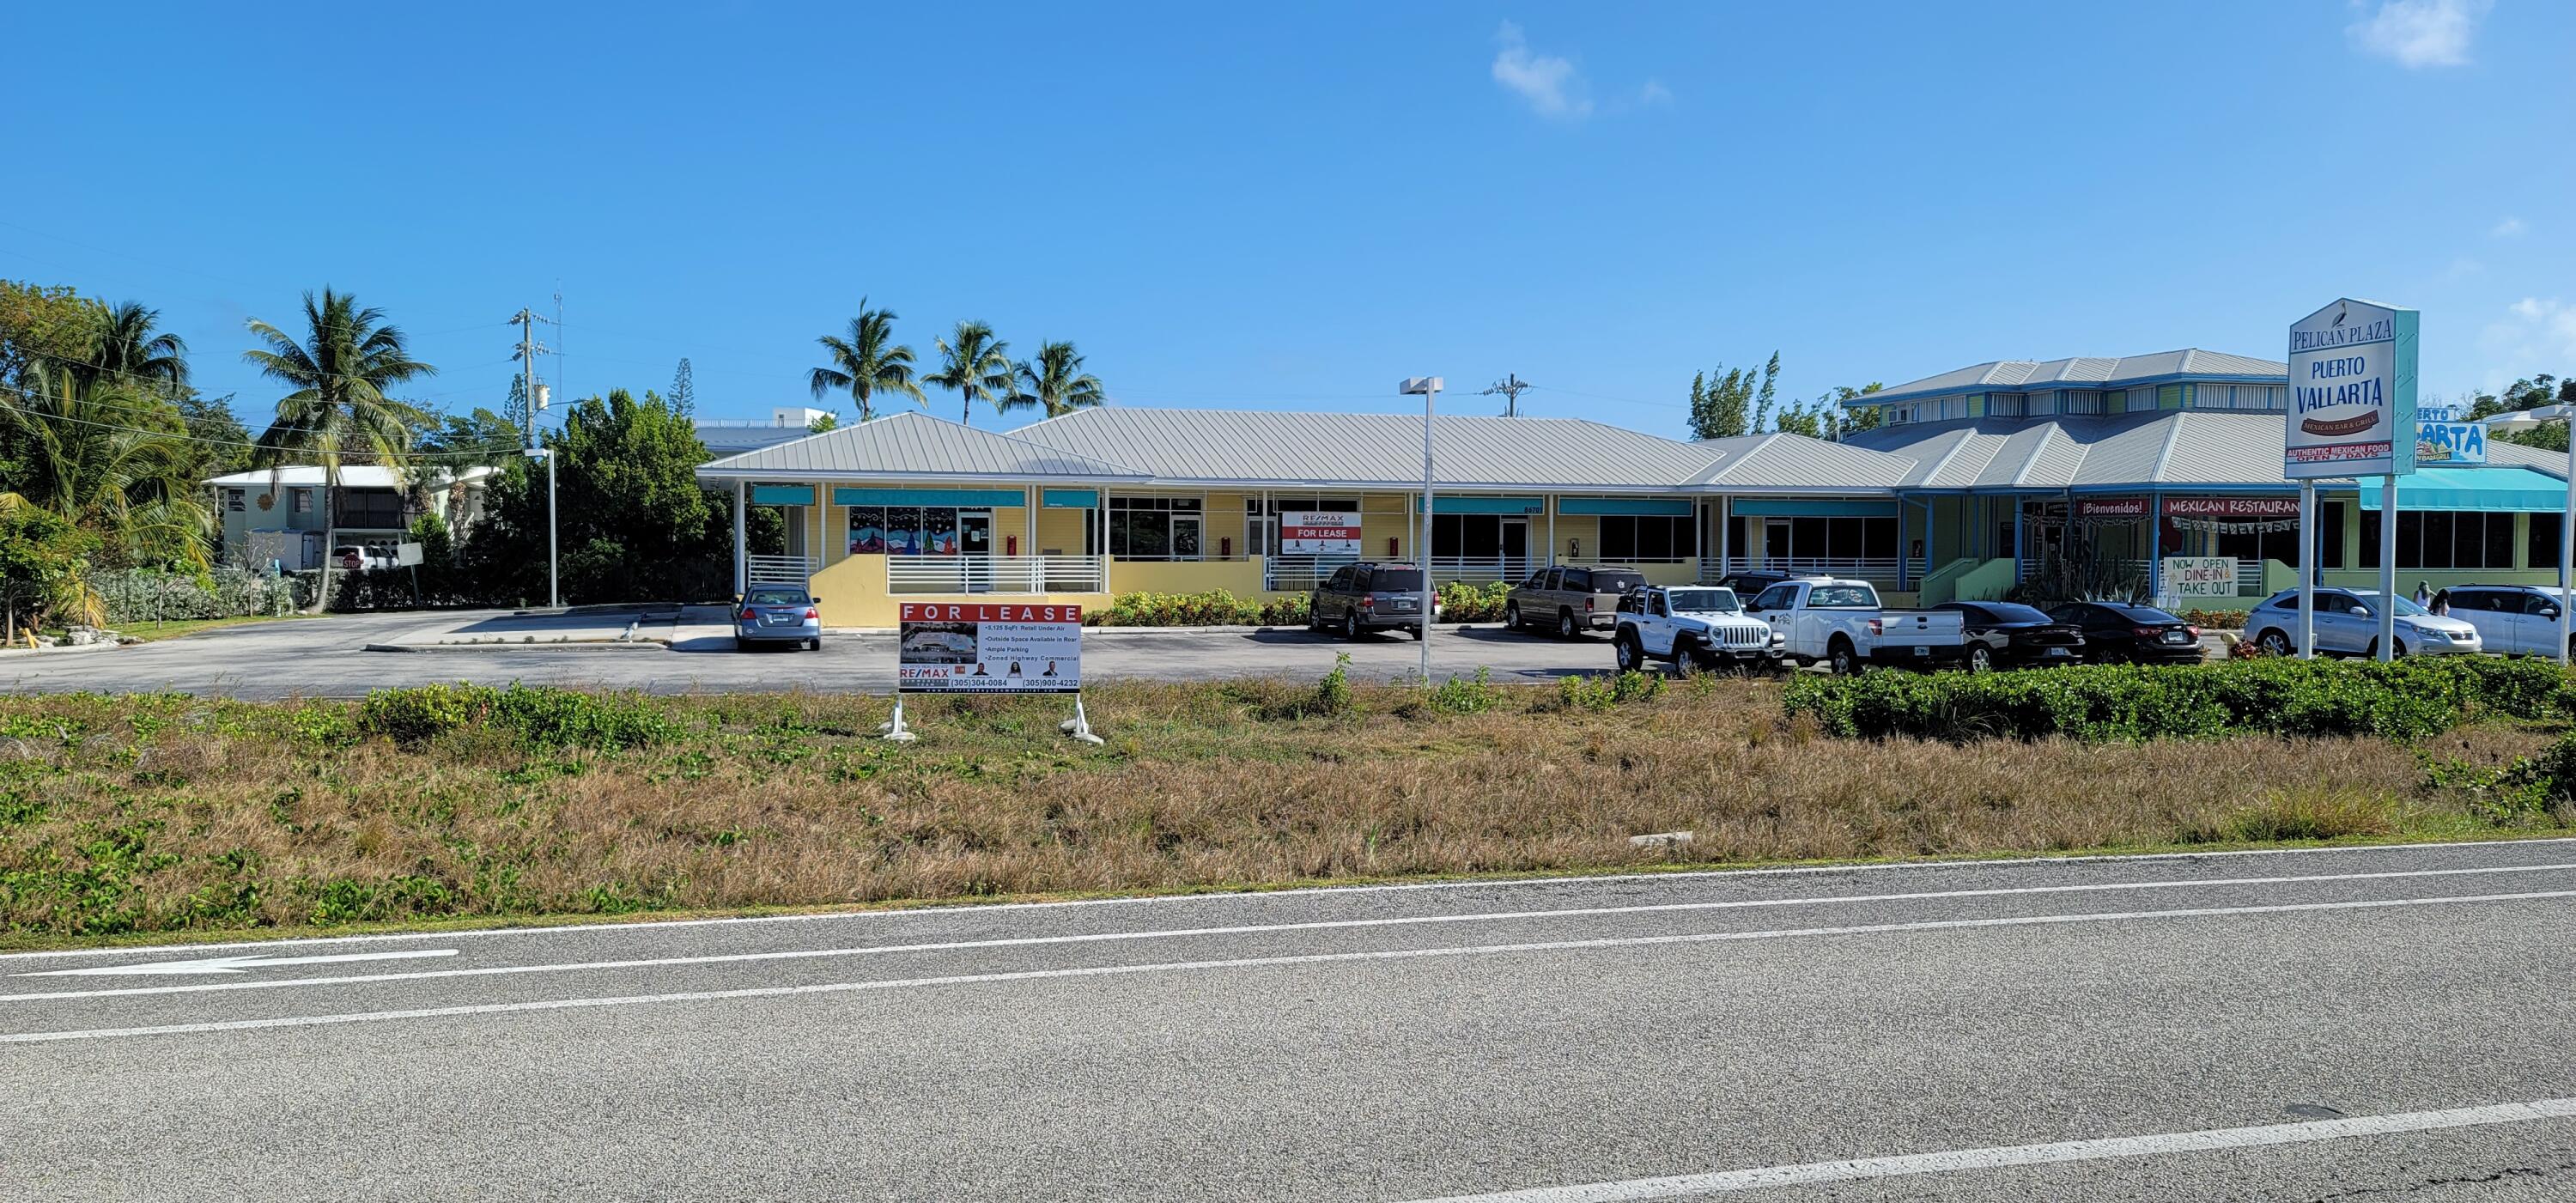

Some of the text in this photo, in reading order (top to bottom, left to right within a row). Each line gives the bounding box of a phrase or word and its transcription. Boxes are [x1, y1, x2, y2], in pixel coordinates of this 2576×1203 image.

[2293, 319, 2392, 350] PELICAN PLAZA
[2312, 356, 2365, 380] PUERTO
[2296, 376, 2383, 414] VALLARTA
[2417, 409, 2449, 420] ERTO
[2304, 422, 2335, 431] MEXICAN
[2355, 416, 2375, 427] GRILL
[2417, 423, 2483, 456] ARTA
[2287, 447, 2330, 457] AUTHENTIC
[2330, 445, 2366, 454] MEXICAN
[2083, 501, 2142, 514] ¡Bienvenidos!
[2170, 501, 2300, 513] MEXICAN RESTAURAN
[1297, 529, 1347, 538] FOR LEASE
[2172, 558, 2229, 568] NOW OPEN
[2184, 568, 2223, 581] DINE-IN
[2178, 580, 2233, 595] TAKE OUT
[903, 605, 1077, 621] FOR LEASE
[900, 668, 949, 678] RE/MAX
